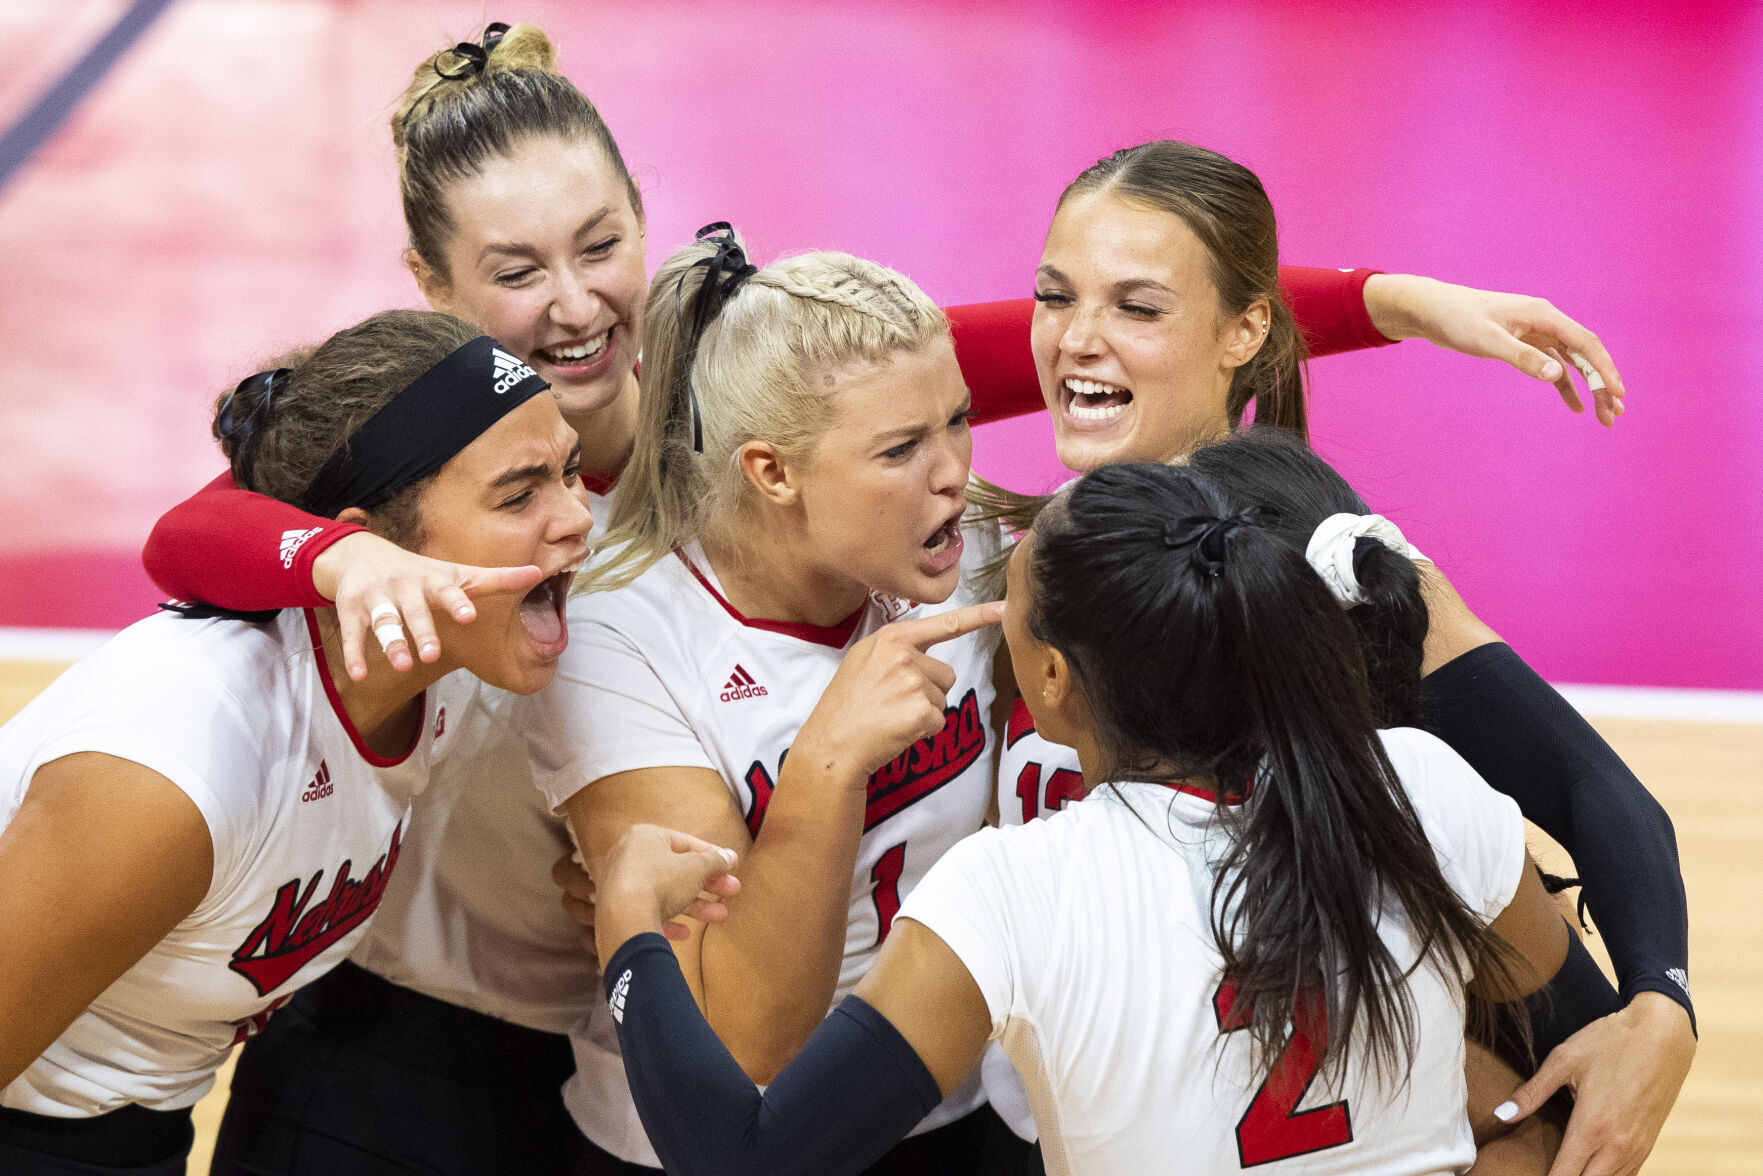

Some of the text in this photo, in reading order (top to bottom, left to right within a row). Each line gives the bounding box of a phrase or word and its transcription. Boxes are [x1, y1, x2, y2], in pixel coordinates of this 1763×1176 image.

[493, 363, 537, 394] adida
[719, 684, 768, 702] adidas
[302, 783, 334, 803] adidas
[230, 818, 402, 965] Nebrask
[870, 841, 908, 946] 1
[1212, 957, 1354, 1169] 2
